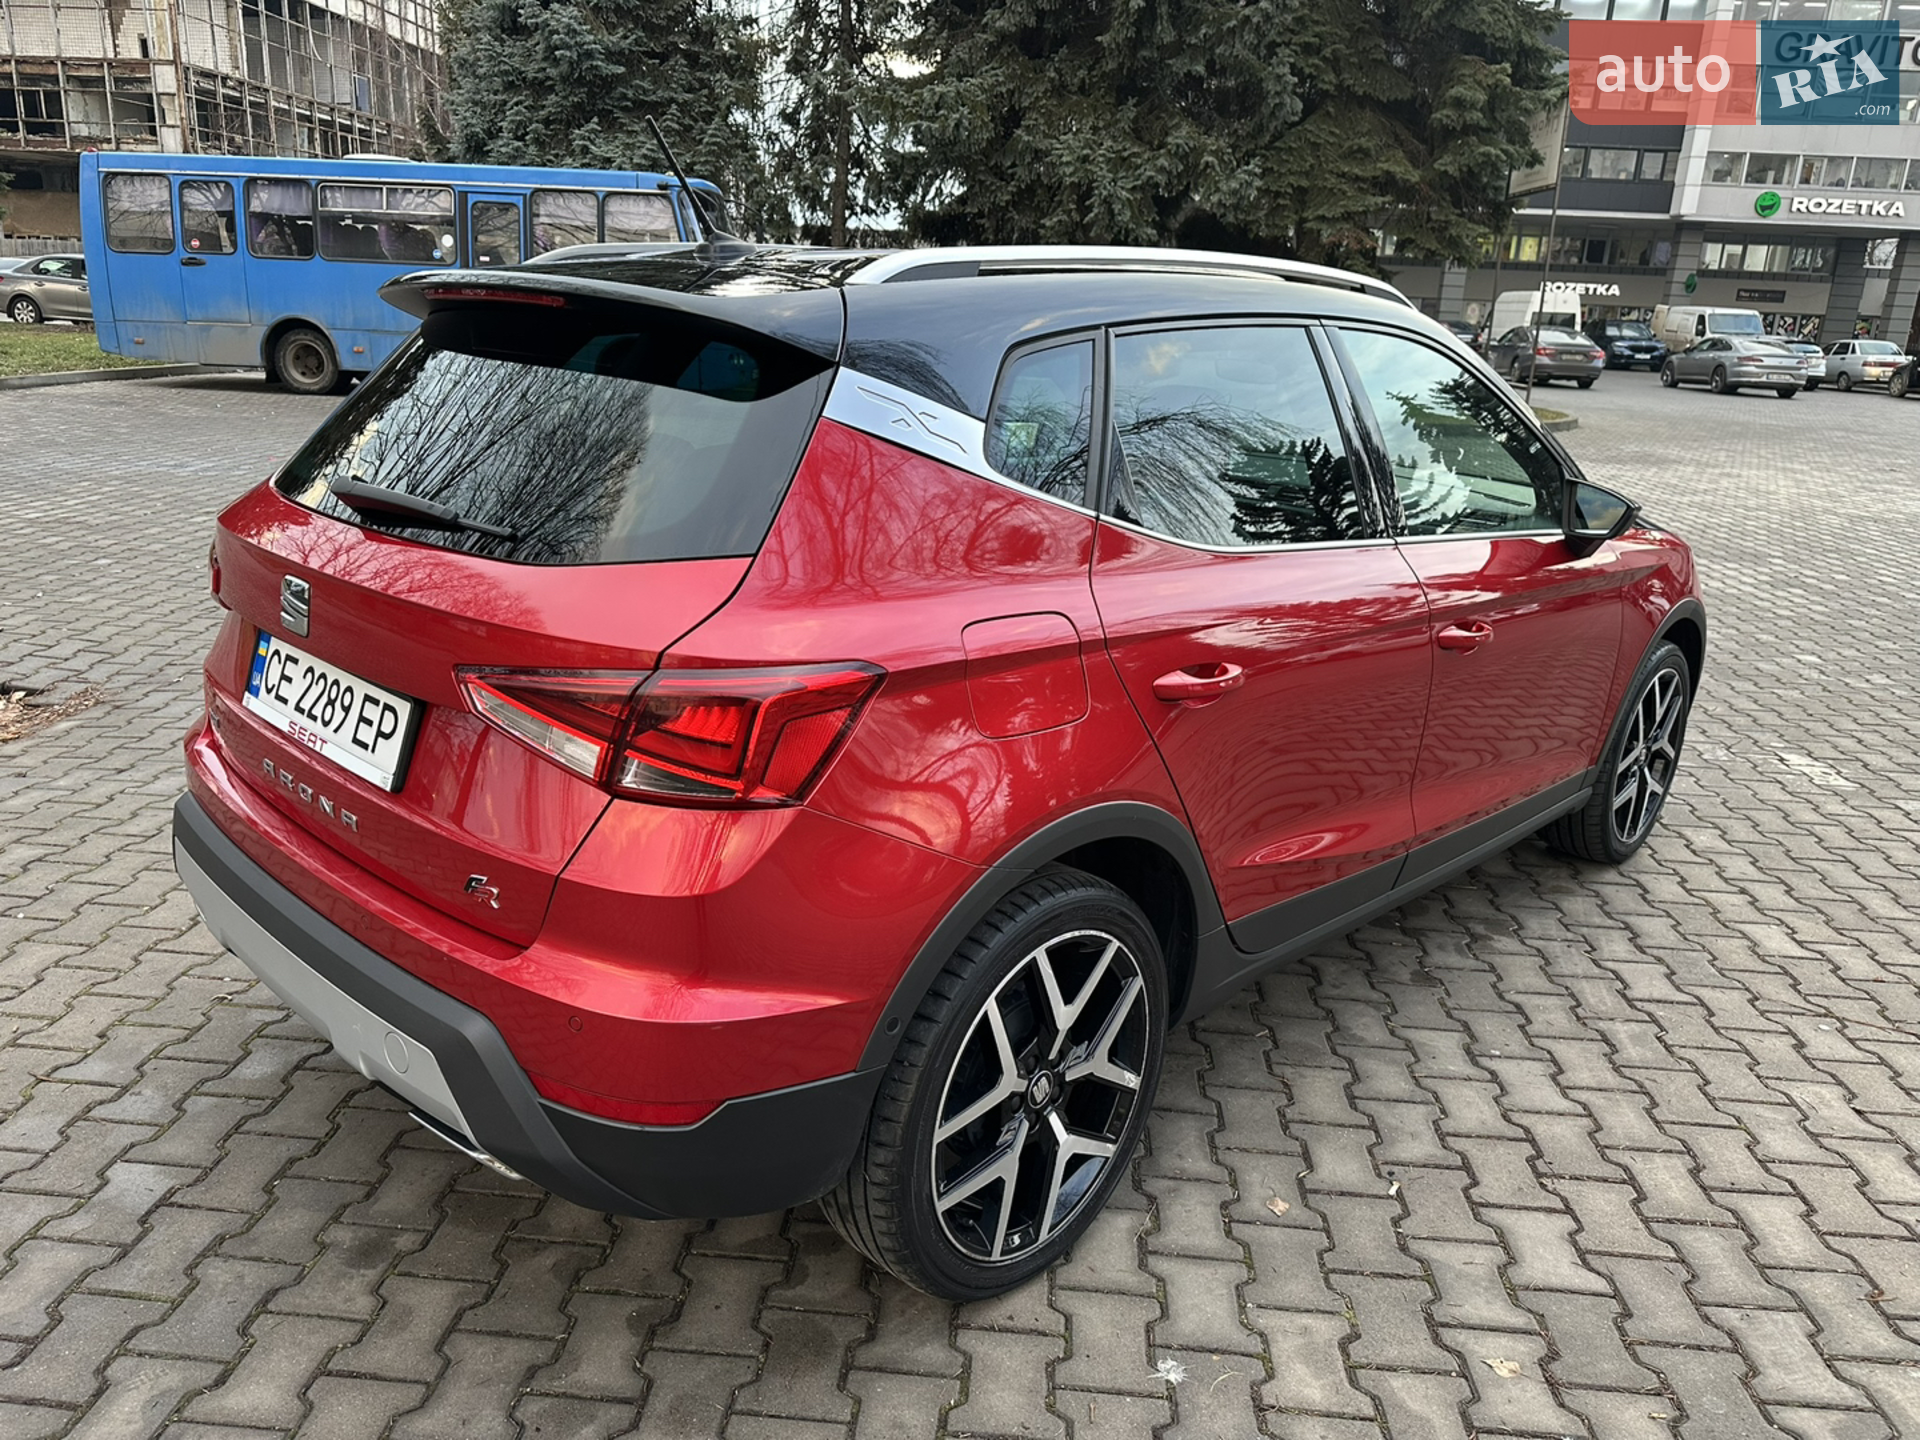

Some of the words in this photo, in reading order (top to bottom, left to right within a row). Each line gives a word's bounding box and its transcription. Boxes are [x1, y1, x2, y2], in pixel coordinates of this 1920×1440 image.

[1791, 196, 1906, 217] ROZETKA
[1540, 281, 1620, 296] ROZETKA
[265, 648, 299, 706] CE
[294, 665, 354, 734] 2289
[351, 693, 398, 754] EP
[287, 720, 328, 752] SEAT
[262, 757, 358, 832] ARONA
[464, 873, 500, 909] FR
